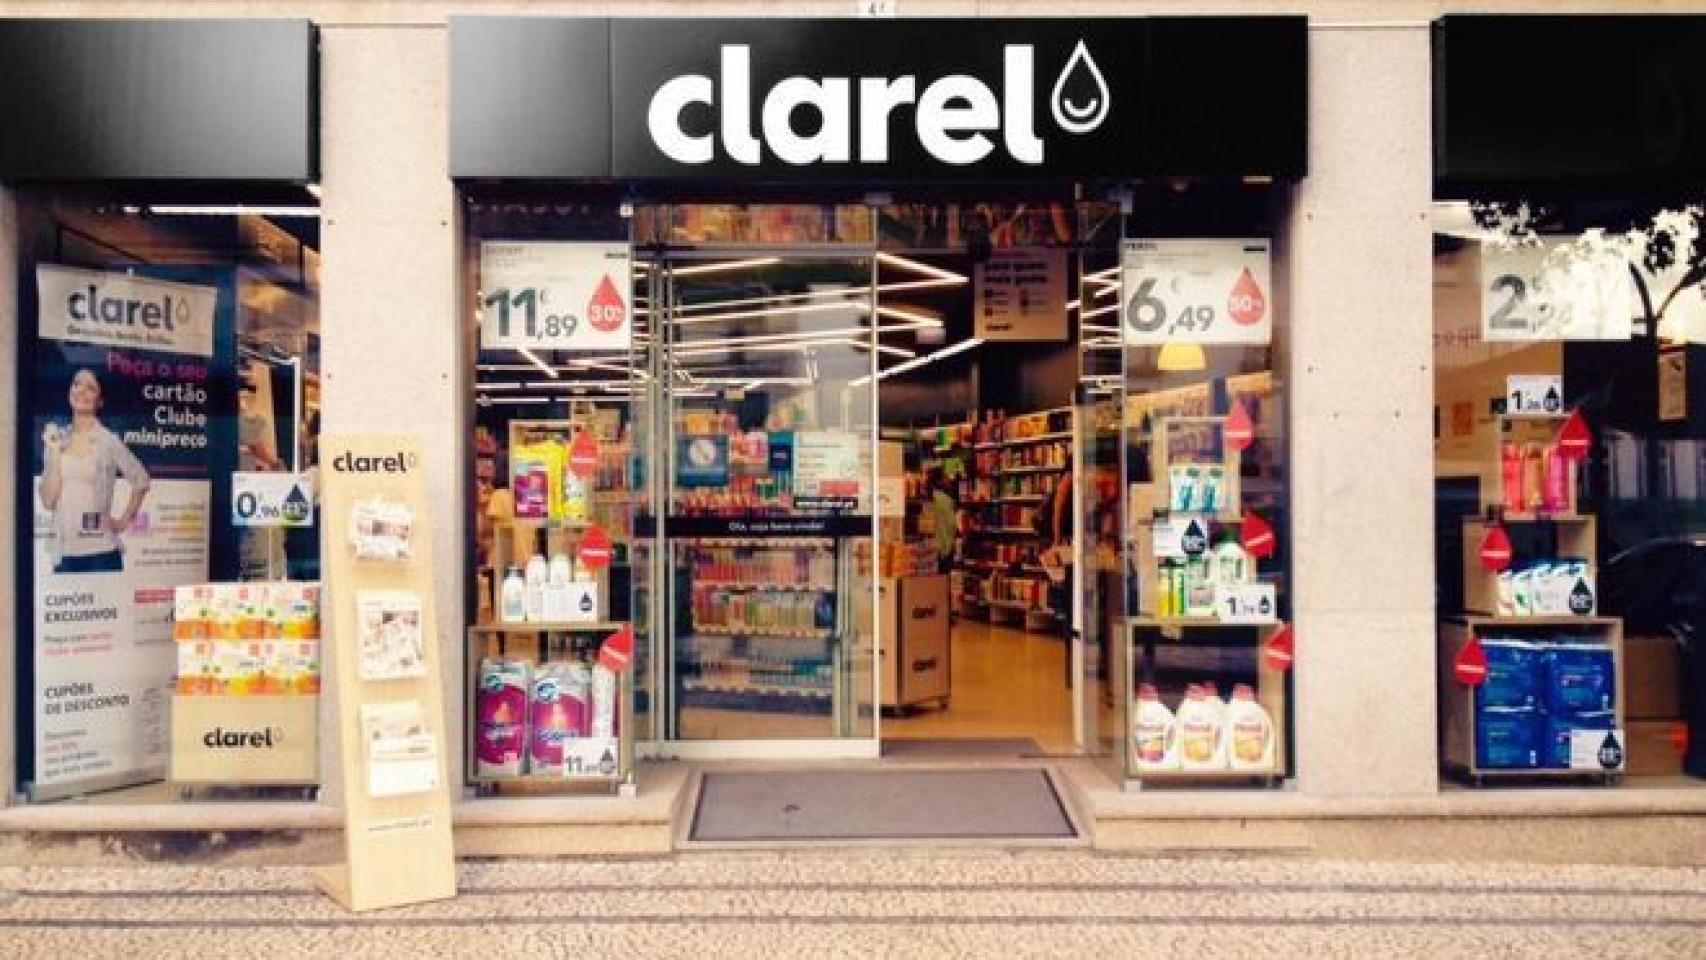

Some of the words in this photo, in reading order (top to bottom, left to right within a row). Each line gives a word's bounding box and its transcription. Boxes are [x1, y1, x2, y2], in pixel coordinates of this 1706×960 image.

[648, 43, 1045, 165] clarel
[66, 284, 174, 331] clarel
[143, 382, 207, 403] cartão
[154, 405, 207, 427] Clube
[333, 451, 407, 474] clarel
[203, 727, 272, 748] clarel
